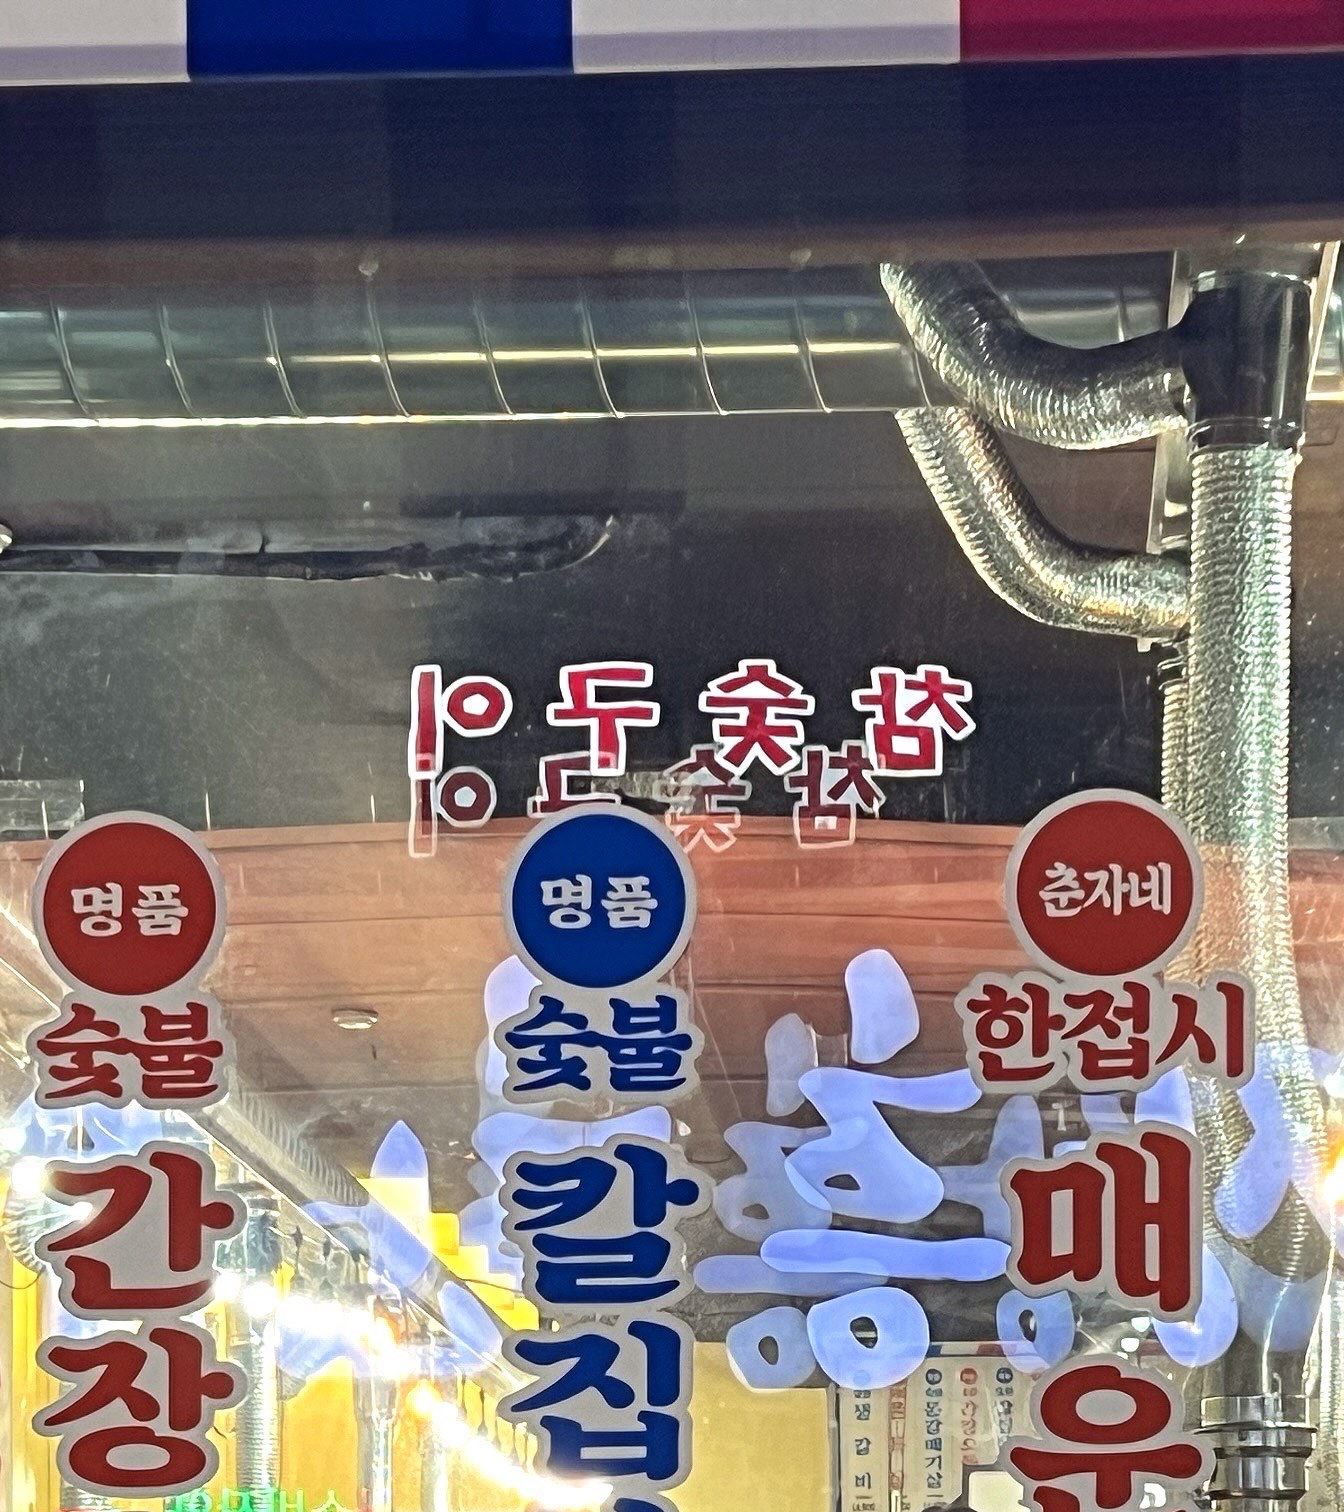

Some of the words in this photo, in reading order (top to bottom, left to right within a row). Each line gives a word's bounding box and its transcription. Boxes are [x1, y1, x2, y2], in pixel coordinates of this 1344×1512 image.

[71, 882, 190, 939] 명품
[540, 873, 659, 930] 명품
[1038, 861, 1172, 918] 춘자네
[35, 1001, 224, 1100] 숯불
[504, 993, 693, 1091] 숯불
[966, 980, 1246, 1084] 한접시
